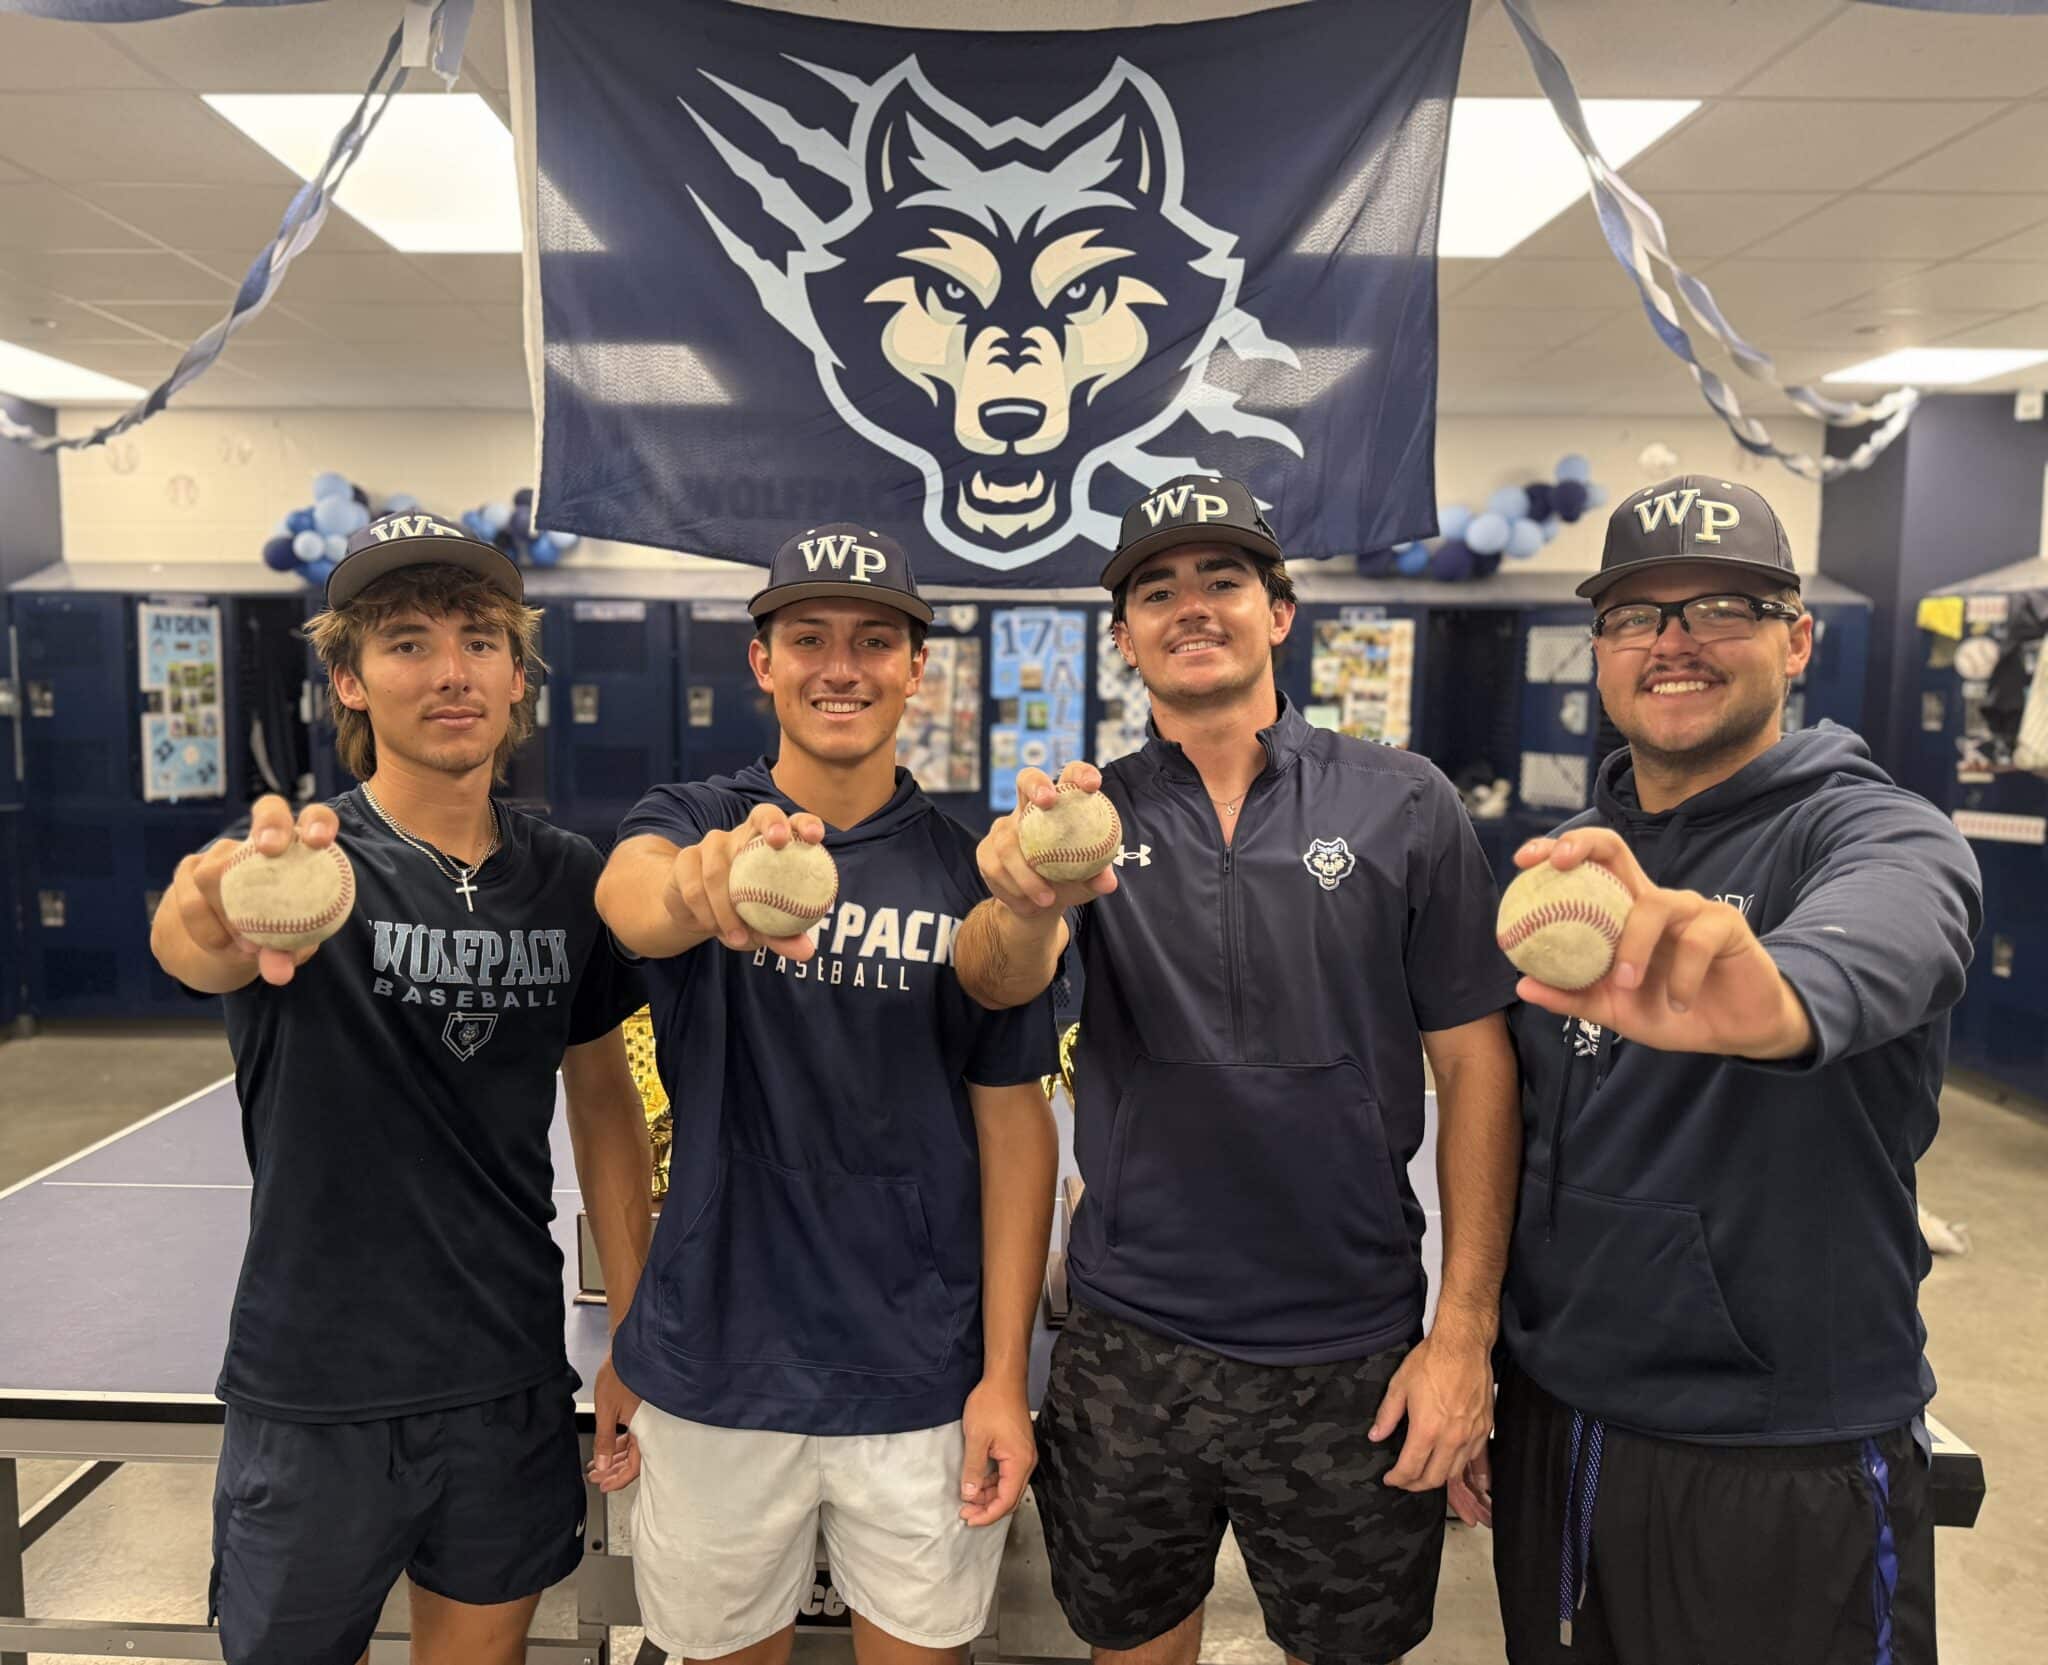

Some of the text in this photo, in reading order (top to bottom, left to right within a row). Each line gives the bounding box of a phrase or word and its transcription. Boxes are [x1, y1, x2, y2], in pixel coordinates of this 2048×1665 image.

[1141, 484, 1229, 527] WP
[1634, 488, 1740, 543] WP
[798, 535, 887, 582] WP
[152, 615, 210, 635] AYDEN
[998, 617, 1053, 657] 17
[368, 919, 571, 986] WOLFPACK
[807, 902, 963, 968] FPACK
[752, 946, 910, 991] BASEBALL
[373, 977, 558, 1008] BASEBALL
